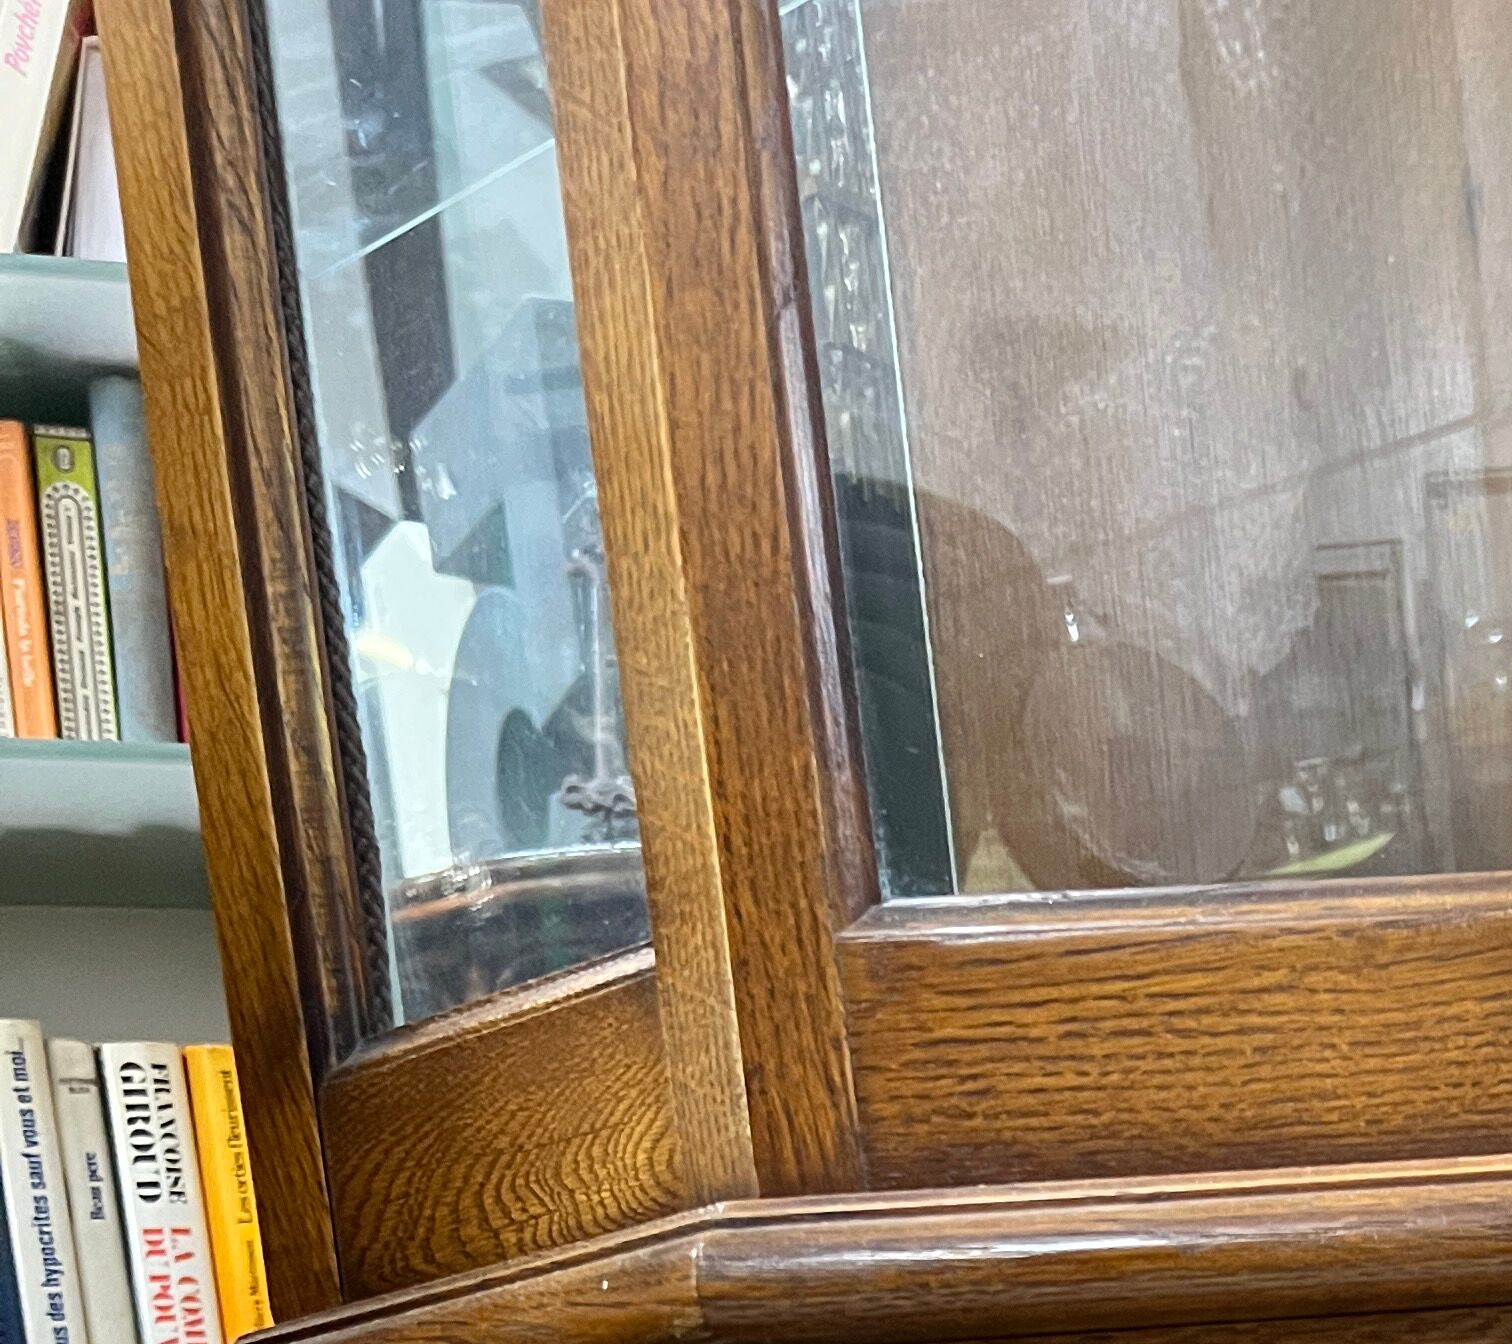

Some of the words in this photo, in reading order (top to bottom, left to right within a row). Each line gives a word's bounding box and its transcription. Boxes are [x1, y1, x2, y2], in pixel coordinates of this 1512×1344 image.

[12, 1085, 33, 1105] et
[19, 1108, 39, 1149] vous
[21, 1153, 46, 1191] sauf
[120, 1062, 162, 1203] GIROUD
[143, 1227, 170, 1268] DU
[31, 1195, 65, 1288] hypocrites
[171, 1227, 196, 1266] LA
[46, 1291, 65, 1322] des
